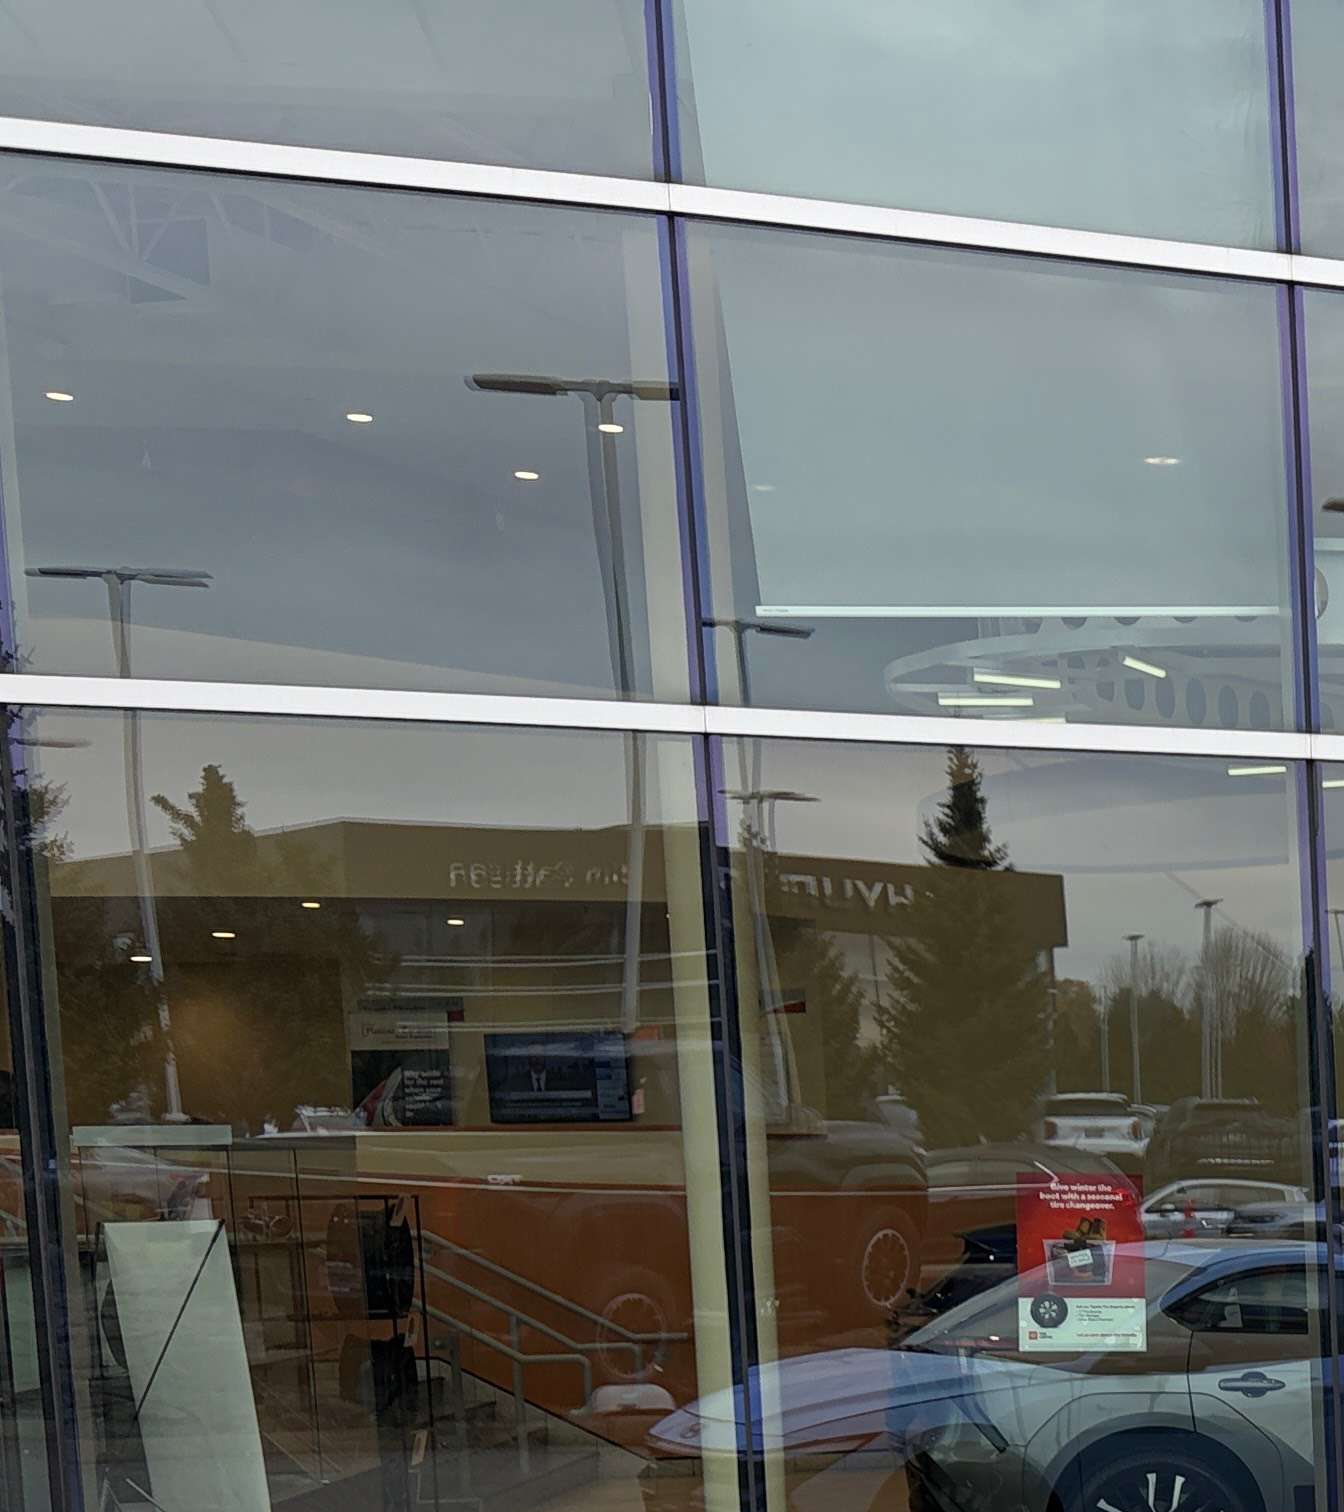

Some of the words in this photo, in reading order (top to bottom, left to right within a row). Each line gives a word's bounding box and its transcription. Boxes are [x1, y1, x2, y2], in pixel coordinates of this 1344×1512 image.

[1050, 1183, 1069, 1191] Give
[1070, 1183, 1097, 1192] winter
[1097, 1183, 1112, 1192] the
[1061, 1192, 1080, 1200] with
